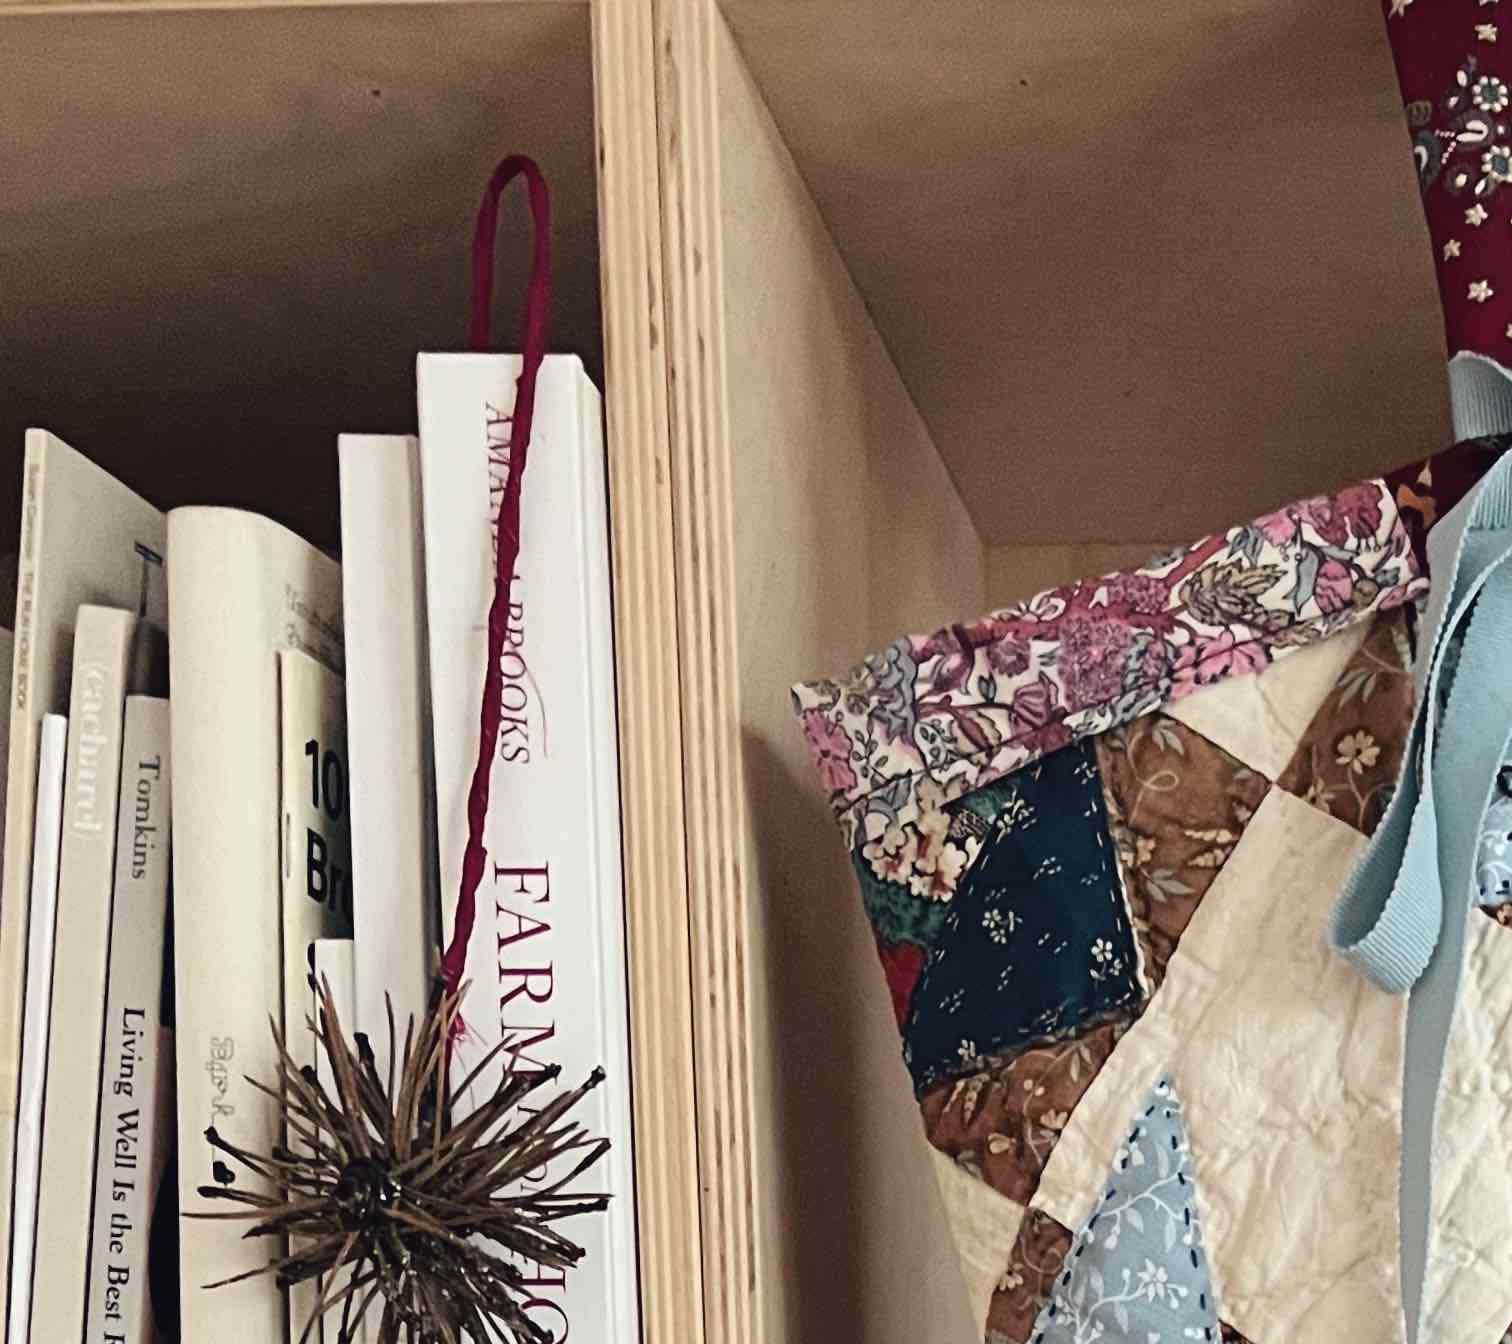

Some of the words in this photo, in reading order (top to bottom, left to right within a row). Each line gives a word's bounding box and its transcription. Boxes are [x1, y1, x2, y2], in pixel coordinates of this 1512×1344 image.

[131, 754, 161, 880] Tomkins
[493, 860, 557, 1083] FARM
[112, 1006, 145, 1099] Living
[114, 1107, 140, 1169] Well
[113, 1179, 136, 1201] Is
[109, 1212, 133, 1253] the
[105, 1264, 130, 1320] Best
